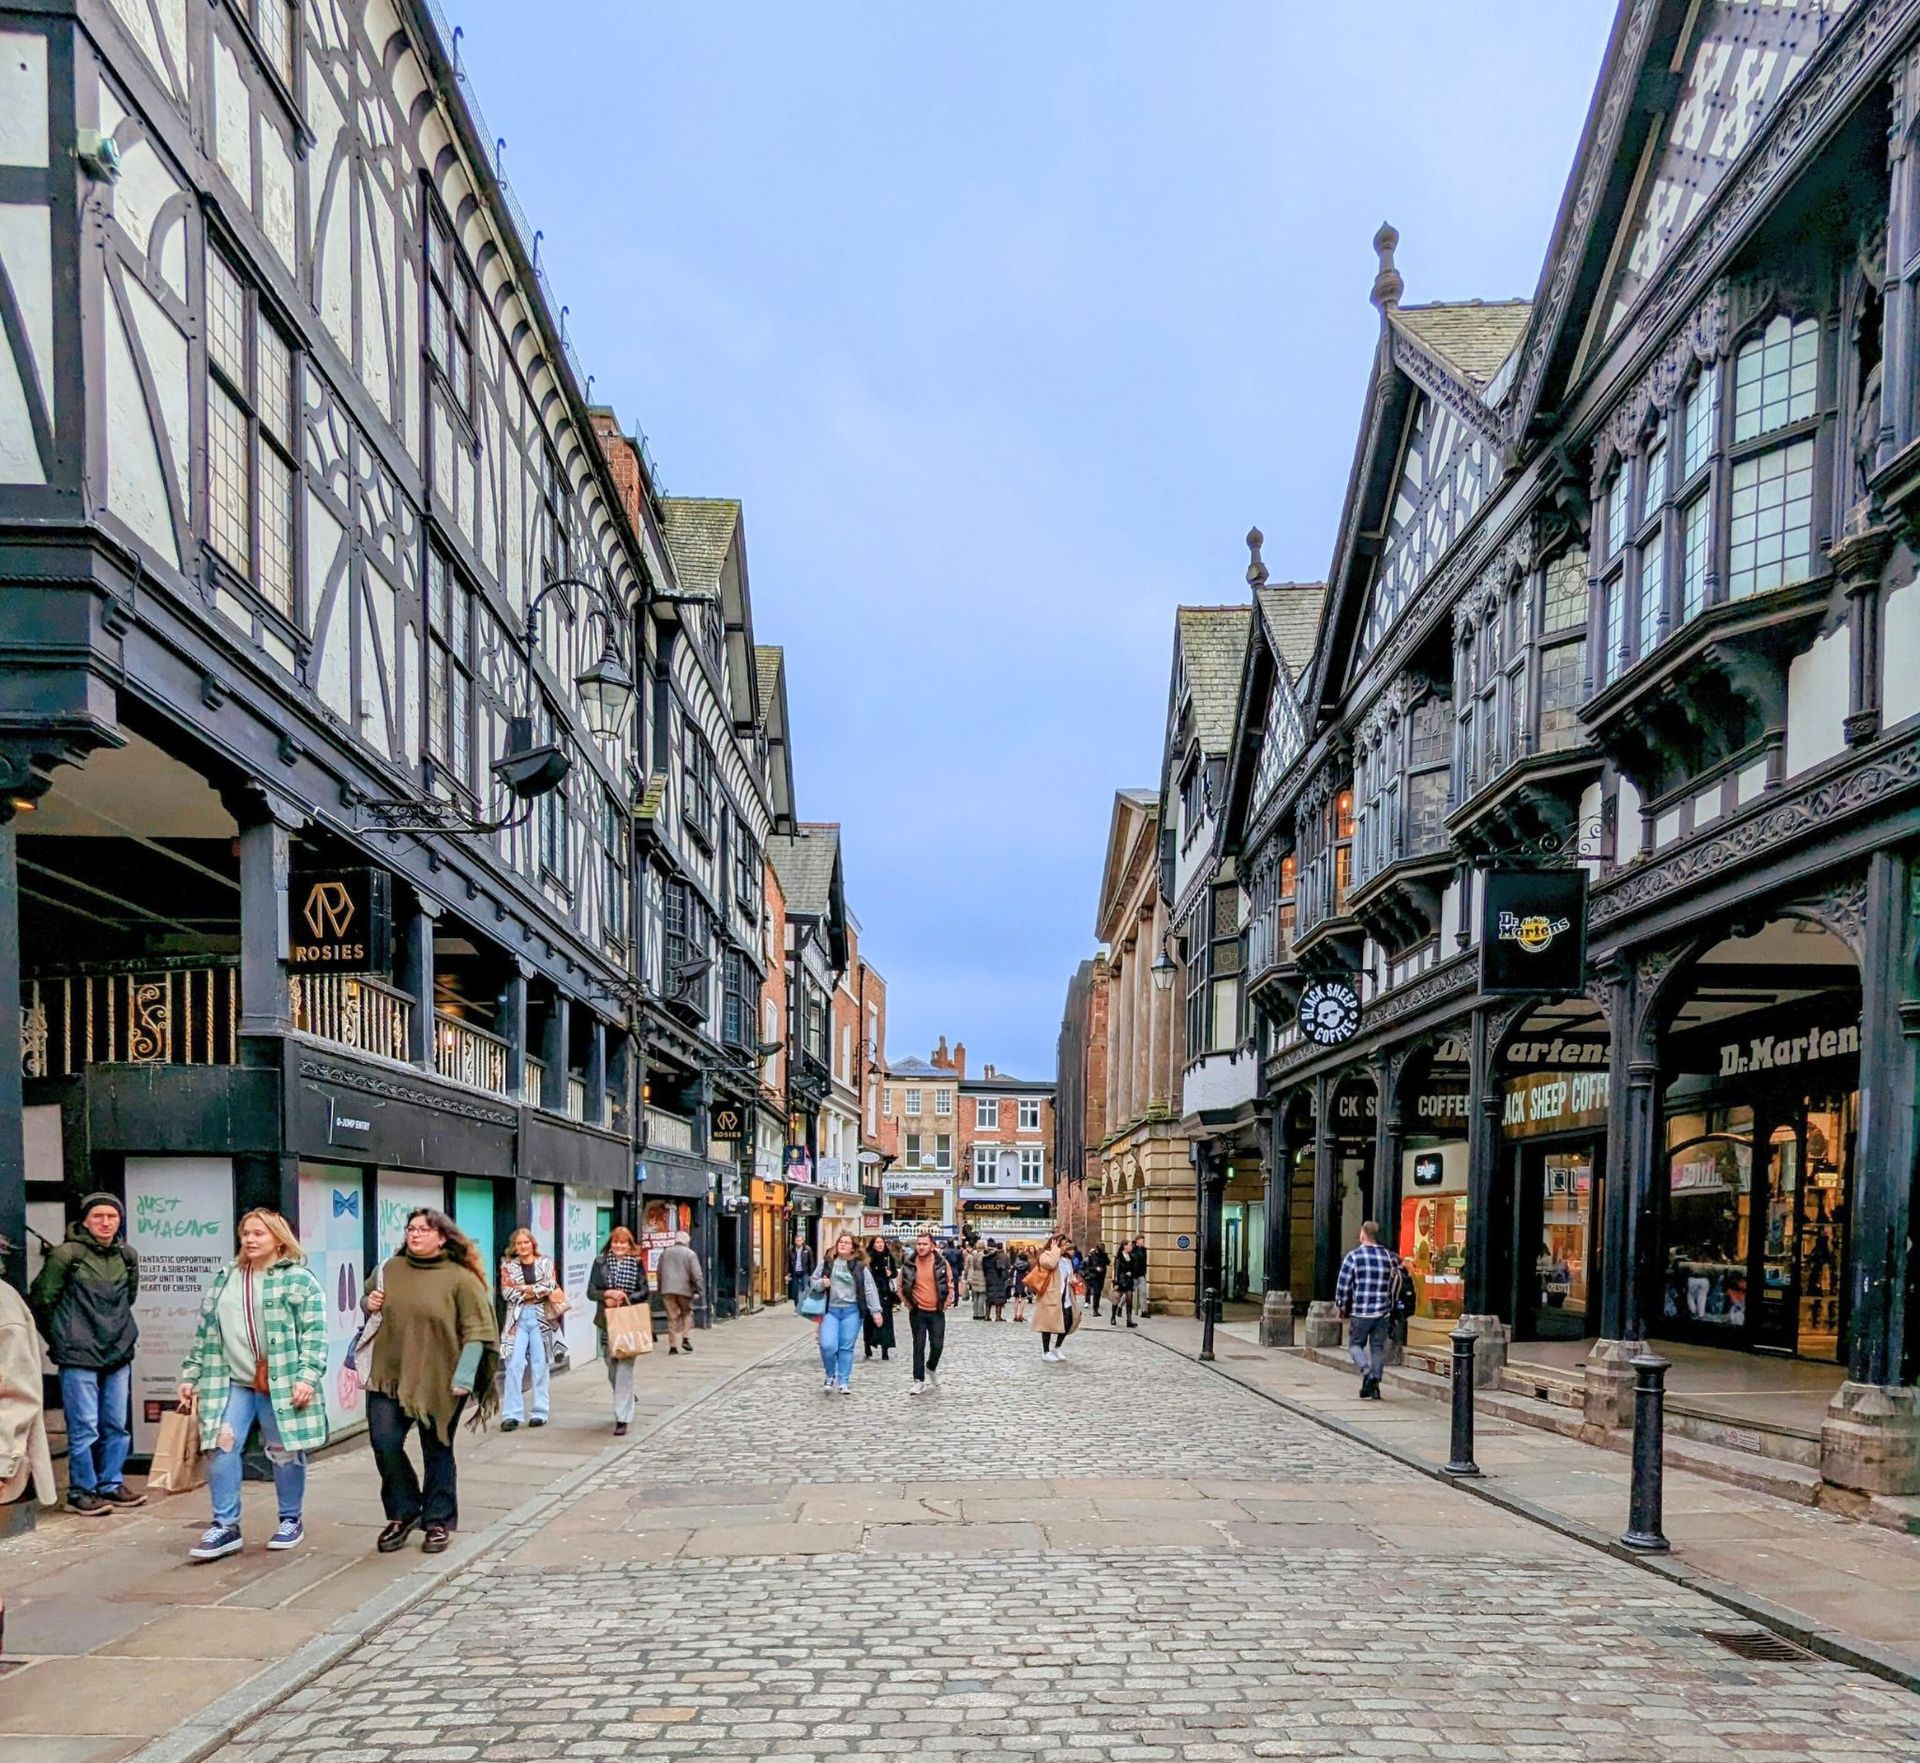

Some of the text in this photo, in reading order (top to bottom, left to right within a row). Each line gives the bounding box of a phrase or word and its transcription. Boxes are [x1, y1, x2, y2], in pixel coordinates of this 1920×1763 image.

[1498, 917, 1570, 940] Martens
[295, 943, 364, 962] ROSIES
[1300, 983, 1358, 1020] BLACK SHEEP
[1314, 1019, 1357, 1044] COFFEE
[1530, 1081, 1567, 1121] SHEEP
[137, 1195, 183, 1215] JUST
[139, 1256, 222, 1264] FANTASTIC OPPORTUNITY
[140, 1265, 213, 1273] TO LET A SUBSTANTIAL
[140, 1275, 197, 1283] SHOP UNIT IN THE
[140, 1284, 202, 1292] HEART OF CHESTER
